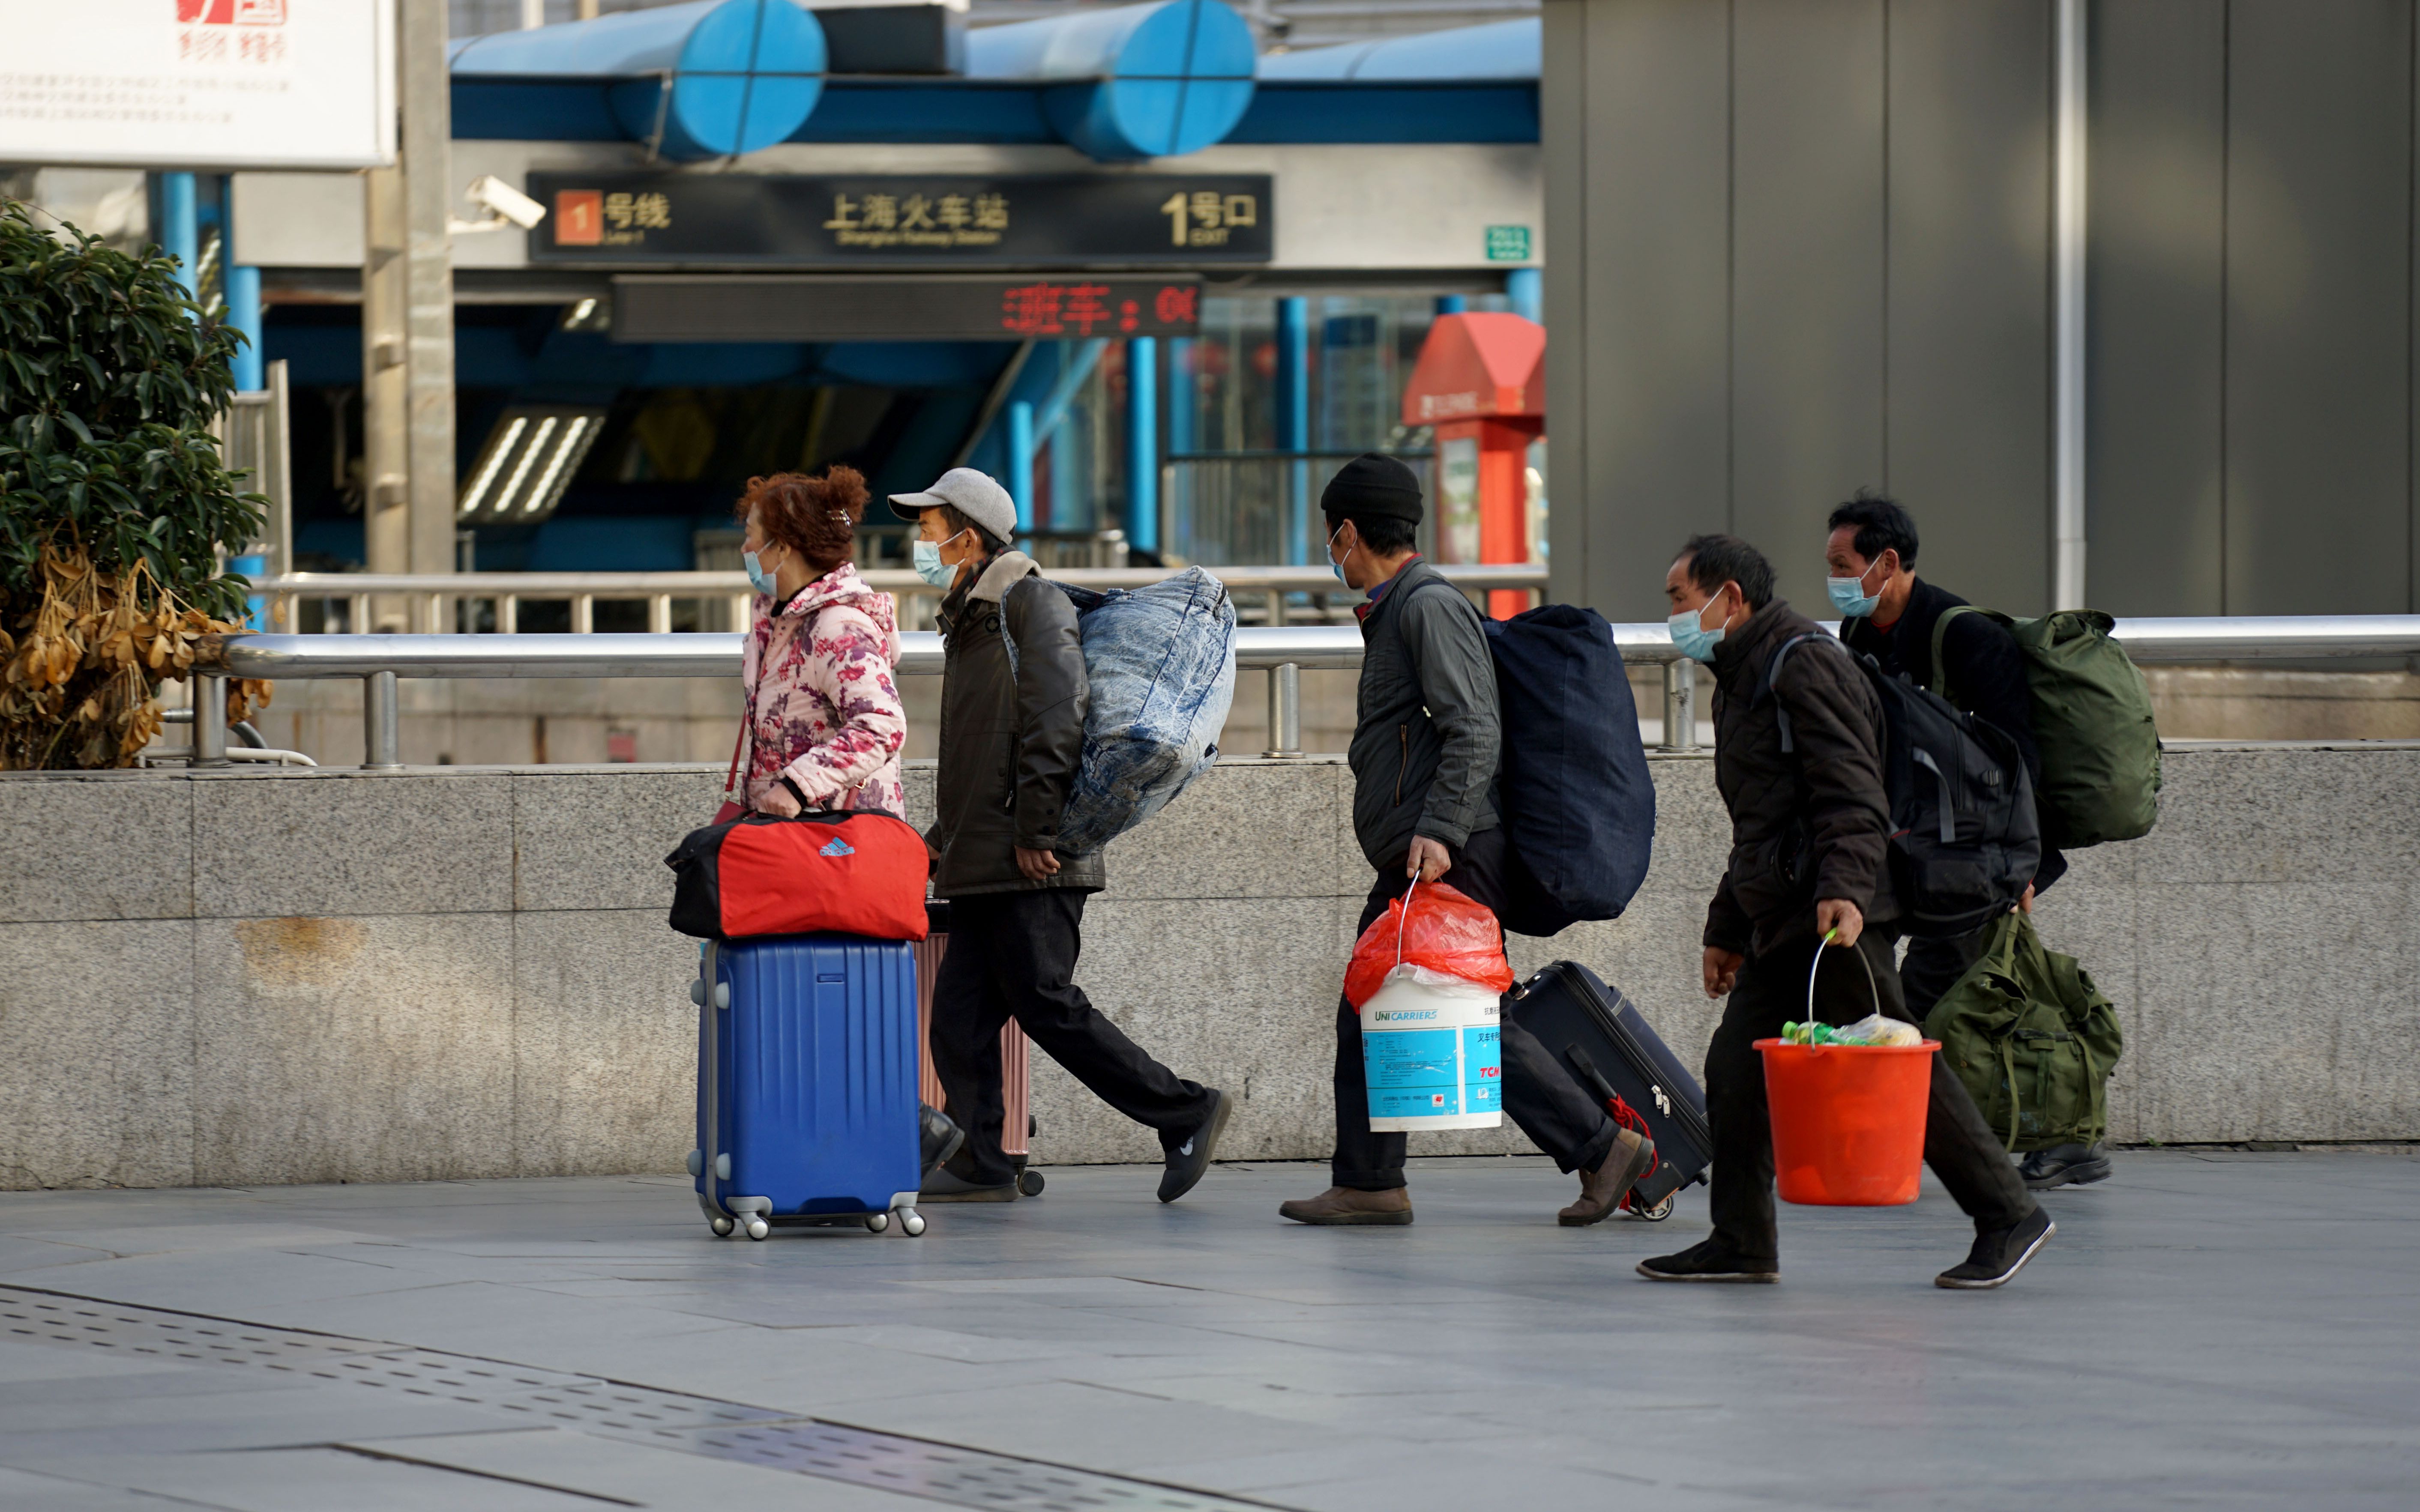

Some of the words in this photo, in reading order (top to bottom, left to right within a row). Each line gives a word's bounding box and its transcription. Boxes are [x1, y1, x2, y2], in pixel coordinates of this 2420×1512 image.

[822, 192, 1009, 230] 上海火车站
[1189, 228, 1229, 246] EXIT
